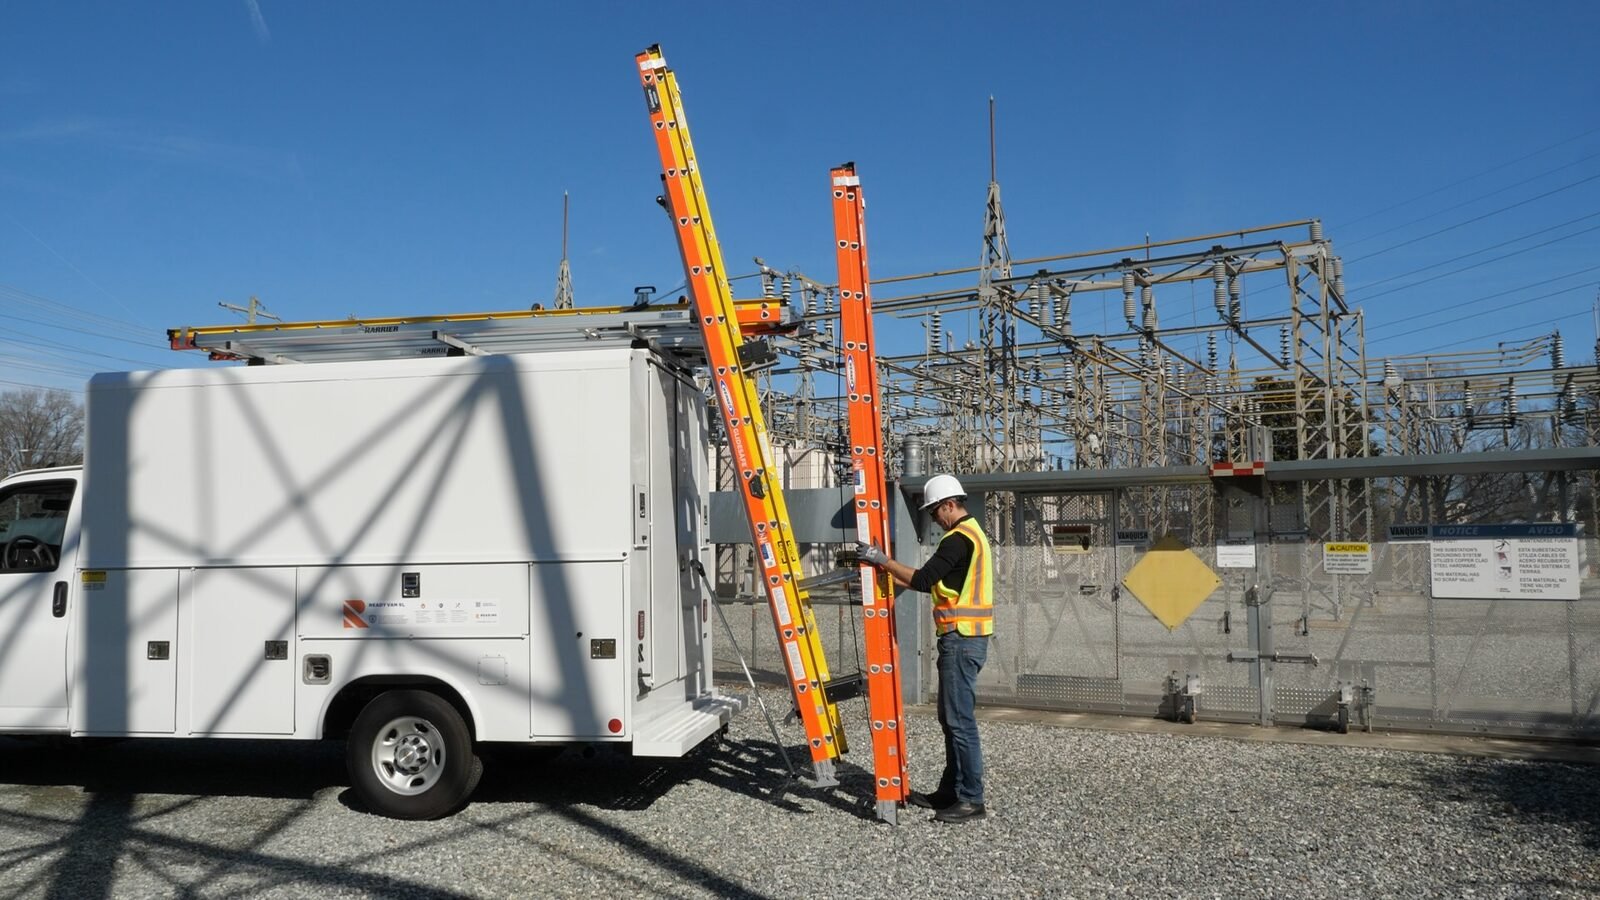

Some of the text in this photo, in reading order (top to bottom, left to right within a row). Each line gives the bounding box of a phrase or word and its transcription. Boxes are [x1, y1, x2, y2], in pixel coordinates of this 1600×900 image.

[733, 428, 748, 467] GLIDESAFE
[1117, 531, 1148, 539] VANQUISH
[1389, 526, 1428, 536] VANQUISH
[1440, 526, 1564, 535] NOTICE AVISO
